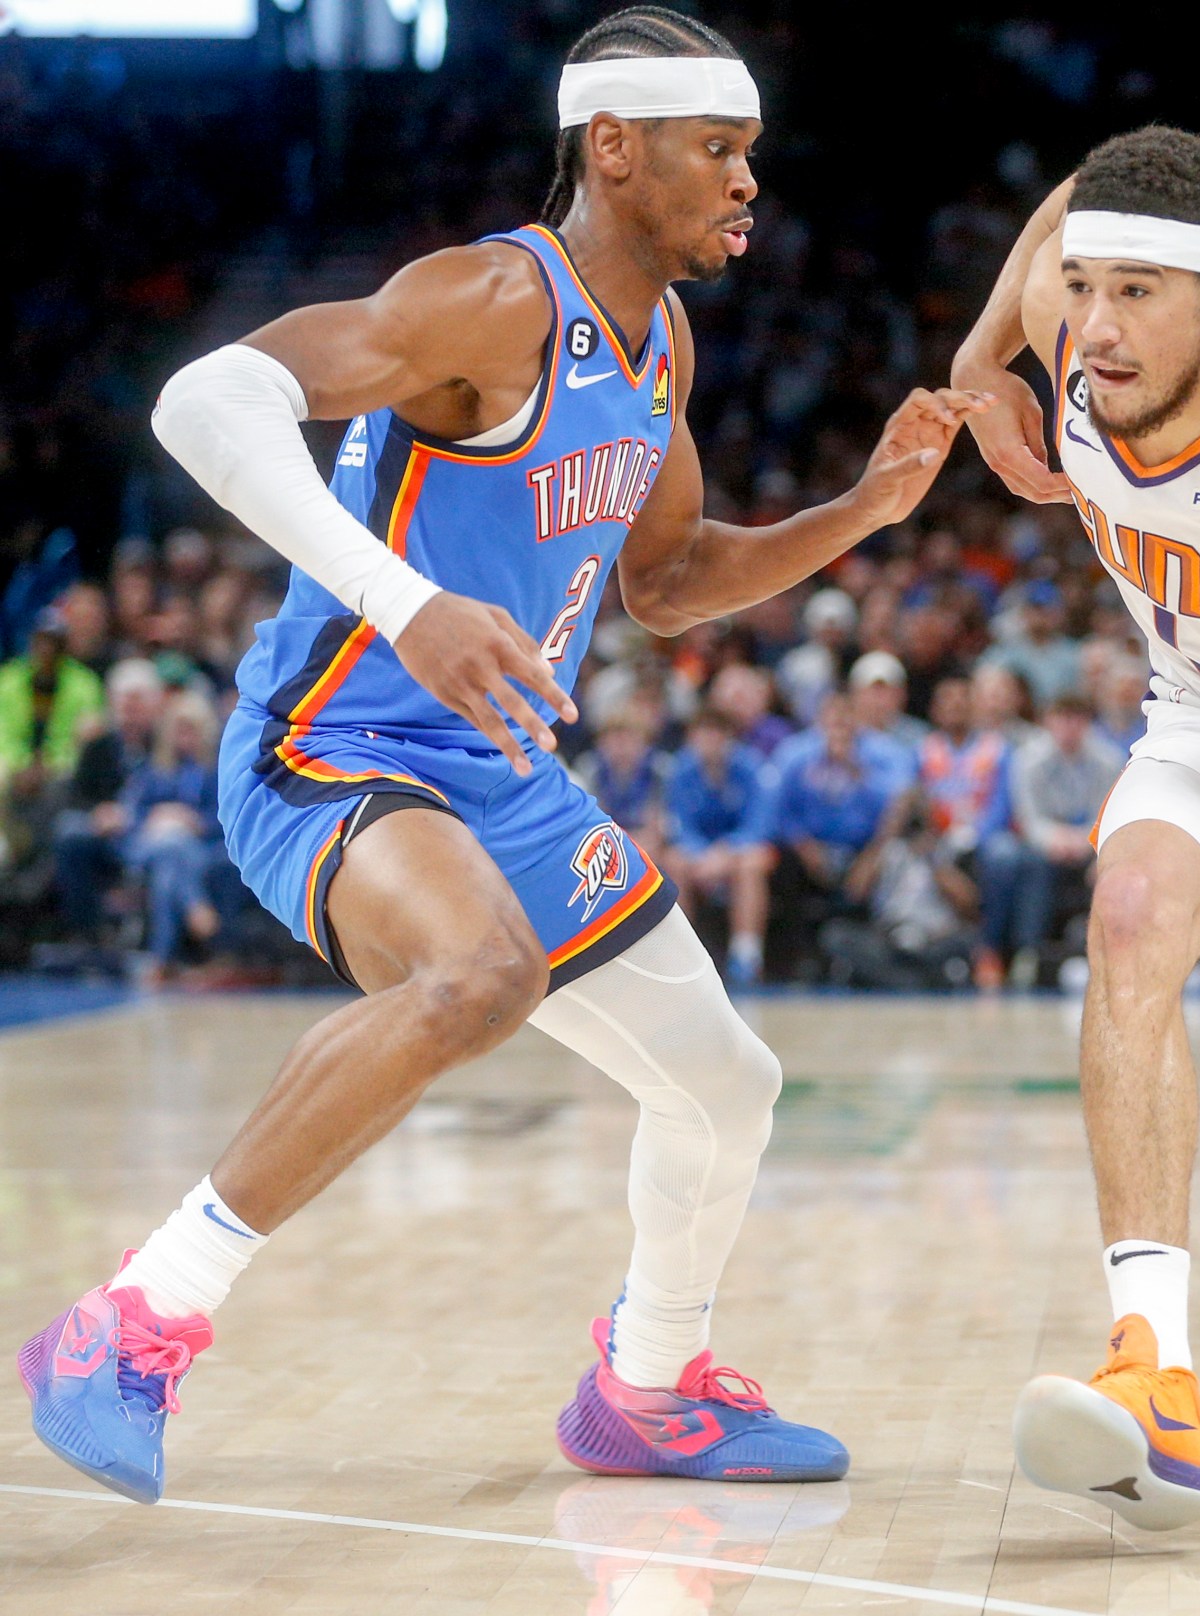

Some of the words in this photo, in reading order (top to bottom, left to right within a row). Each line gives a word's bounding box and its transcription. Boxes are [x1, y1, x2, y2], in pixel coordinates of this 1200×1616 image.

[571, 323, 591, 355] 6
[526, 437, 661, 543] THUNDE
[540, 554, 601, 662] 2
[587, 835, 613, 900] OKC
